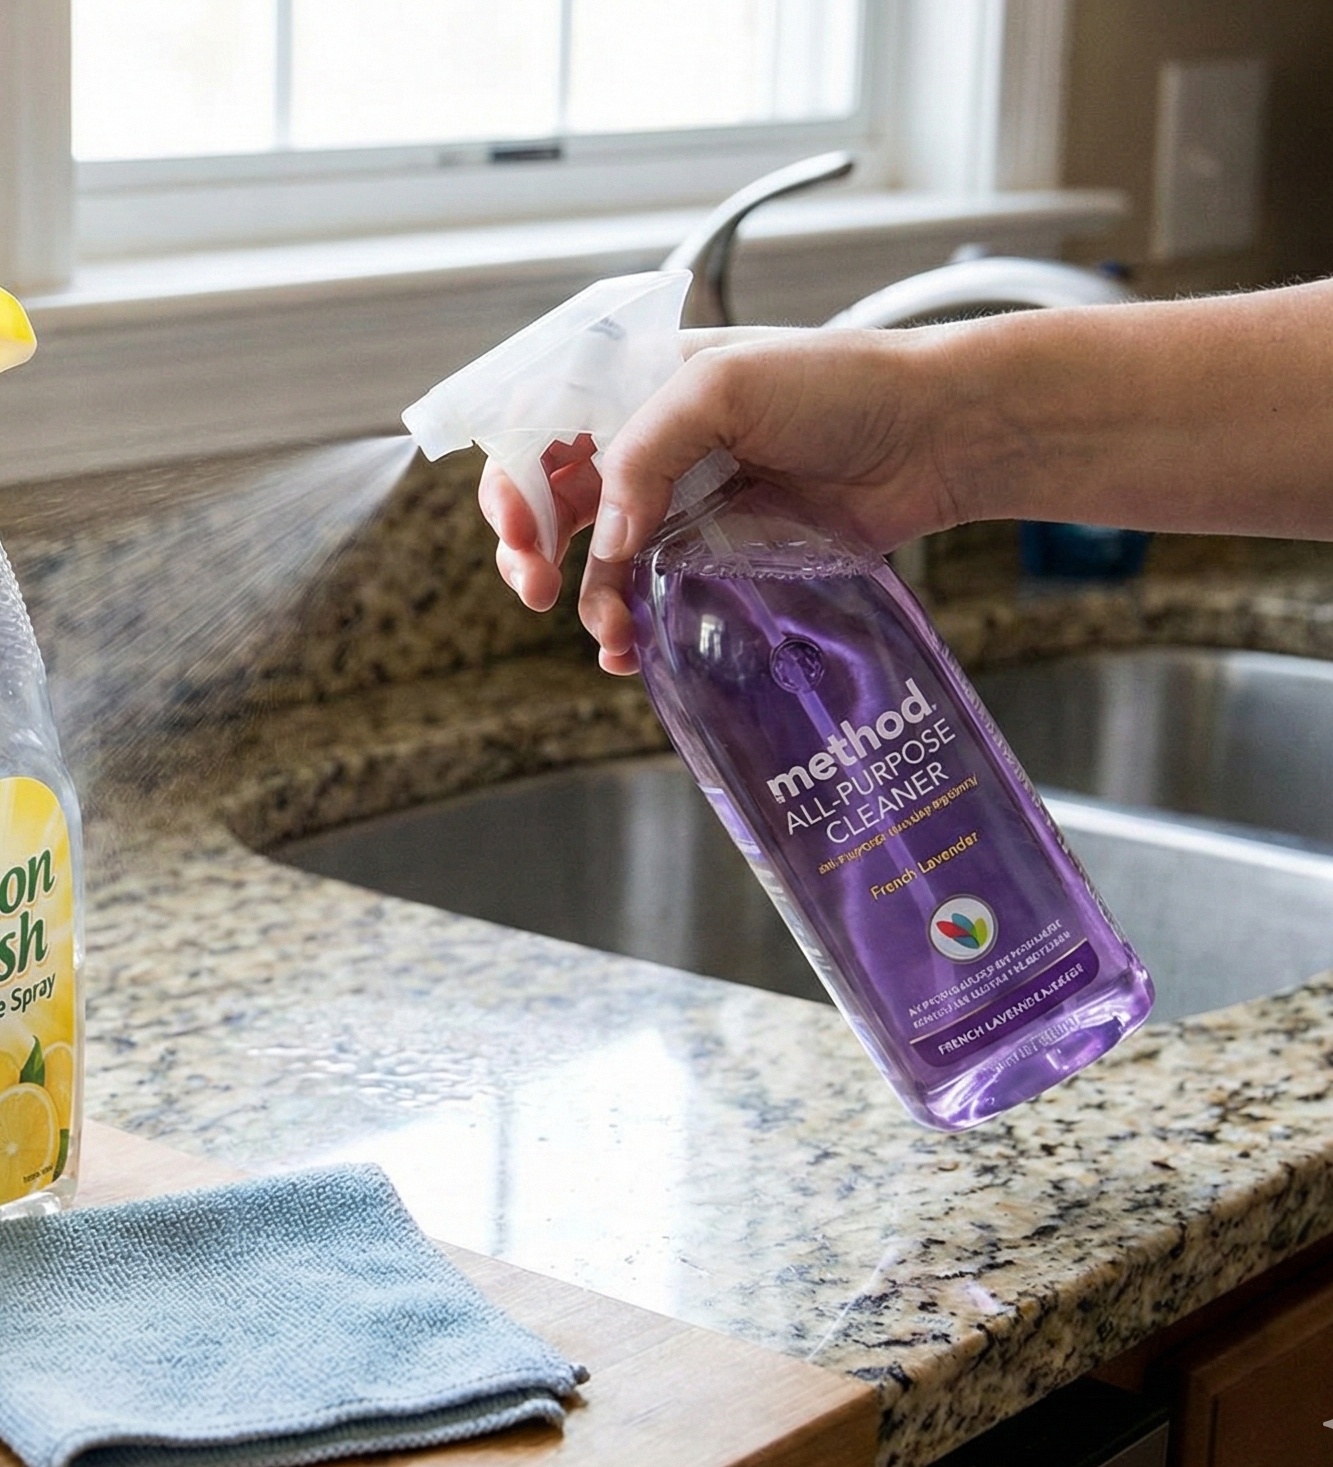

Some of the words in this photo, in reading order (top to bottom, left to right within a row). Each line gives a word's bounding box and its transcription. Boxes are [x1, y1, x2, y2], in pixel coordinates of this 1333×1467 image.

[786, 717, 956, 835] ALL-PURPOSE
[826, 761, 949, 844] CLEANER
[11, 973, 56, 1013] Spray
